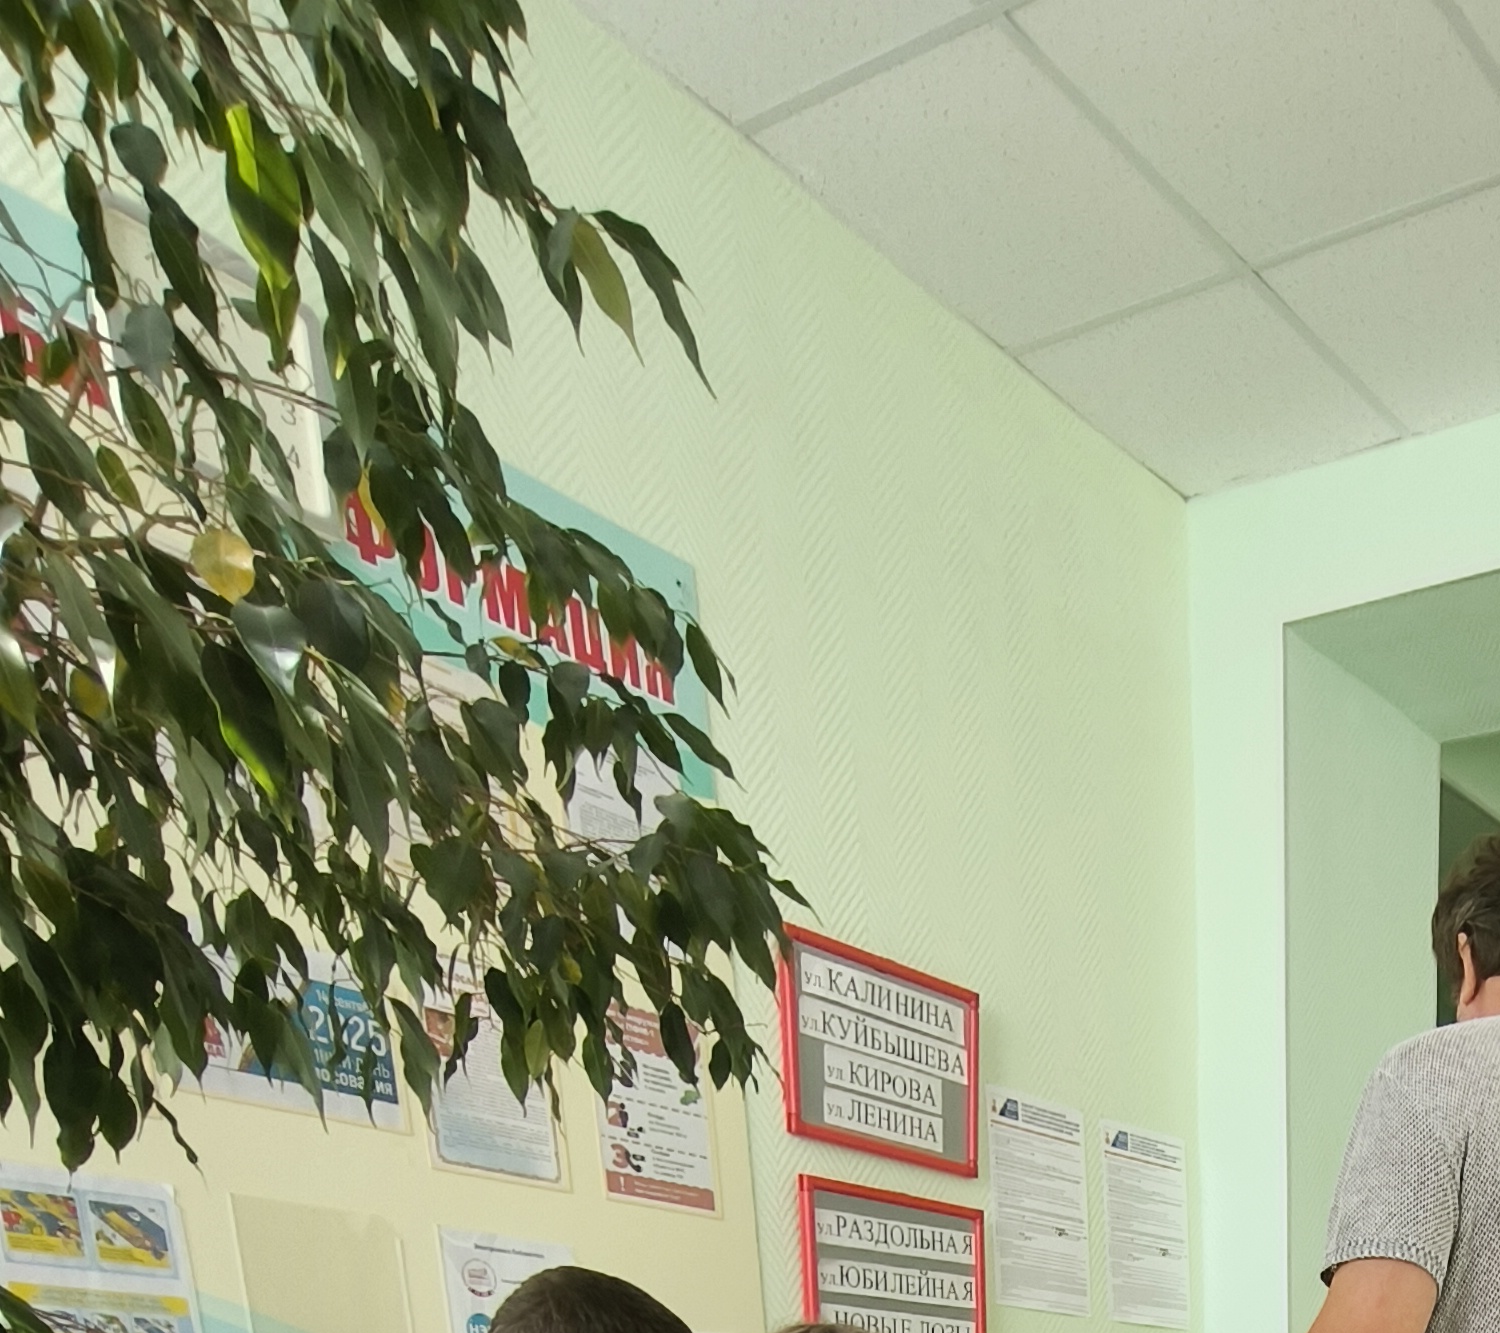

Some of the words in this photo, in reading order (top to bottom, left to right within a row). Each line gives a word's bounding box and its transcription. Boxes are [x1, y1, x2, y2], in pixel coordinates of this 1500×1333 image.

[286, 444, 301, 470] 4
[827, 967, 955, 1033] КАЛИНИНА
[821, 1010, 965, 1077] КУЙБЫШЕВА
[849, 1061, 937, 1107] КИРОВА
[847, 1099, 938, 1143] ЛЕНИНА
[836, 1215, 973, 1256] РАЗДОЛЬНАЯ
[839, 1265, 974, 1302] ЮБИЛЕЙНАЯ
